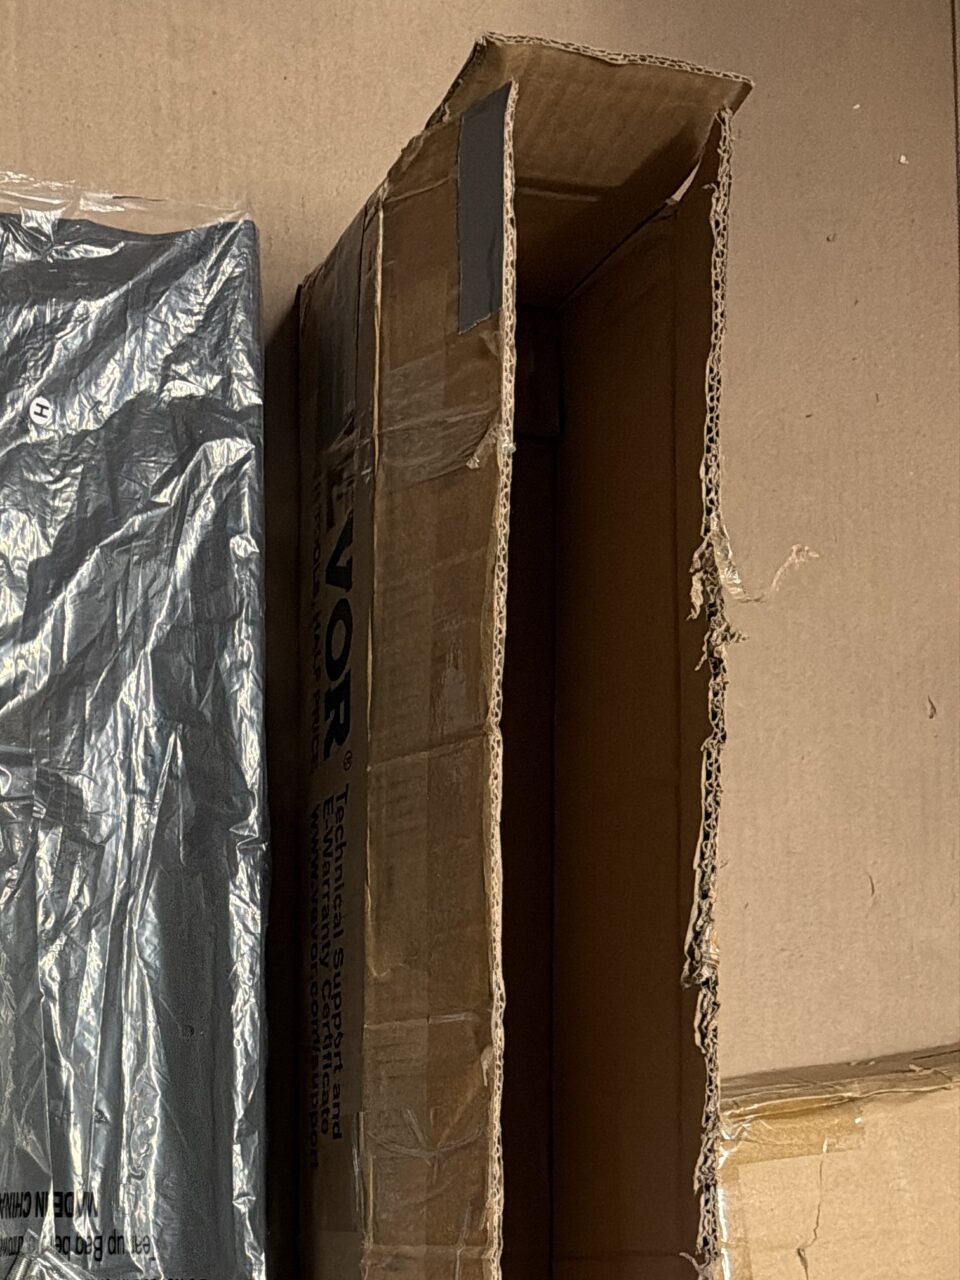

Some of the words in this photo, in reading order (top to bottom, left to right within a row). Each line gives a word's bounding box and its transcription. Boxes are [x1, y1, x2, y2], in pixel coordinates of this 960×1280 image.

[33, 401, 50, 419] H
[318, 795, 333, 968] E-Warranty
[330, 785, 347, 938] Technical
[330, 947, 343, 1070] Support
[320, 980, 331, 1135] Certificate
[331, 1083, 342, 1139] and
[34, 1191, 49, 1217] IN
[108, 1228, 125, 1256] up
